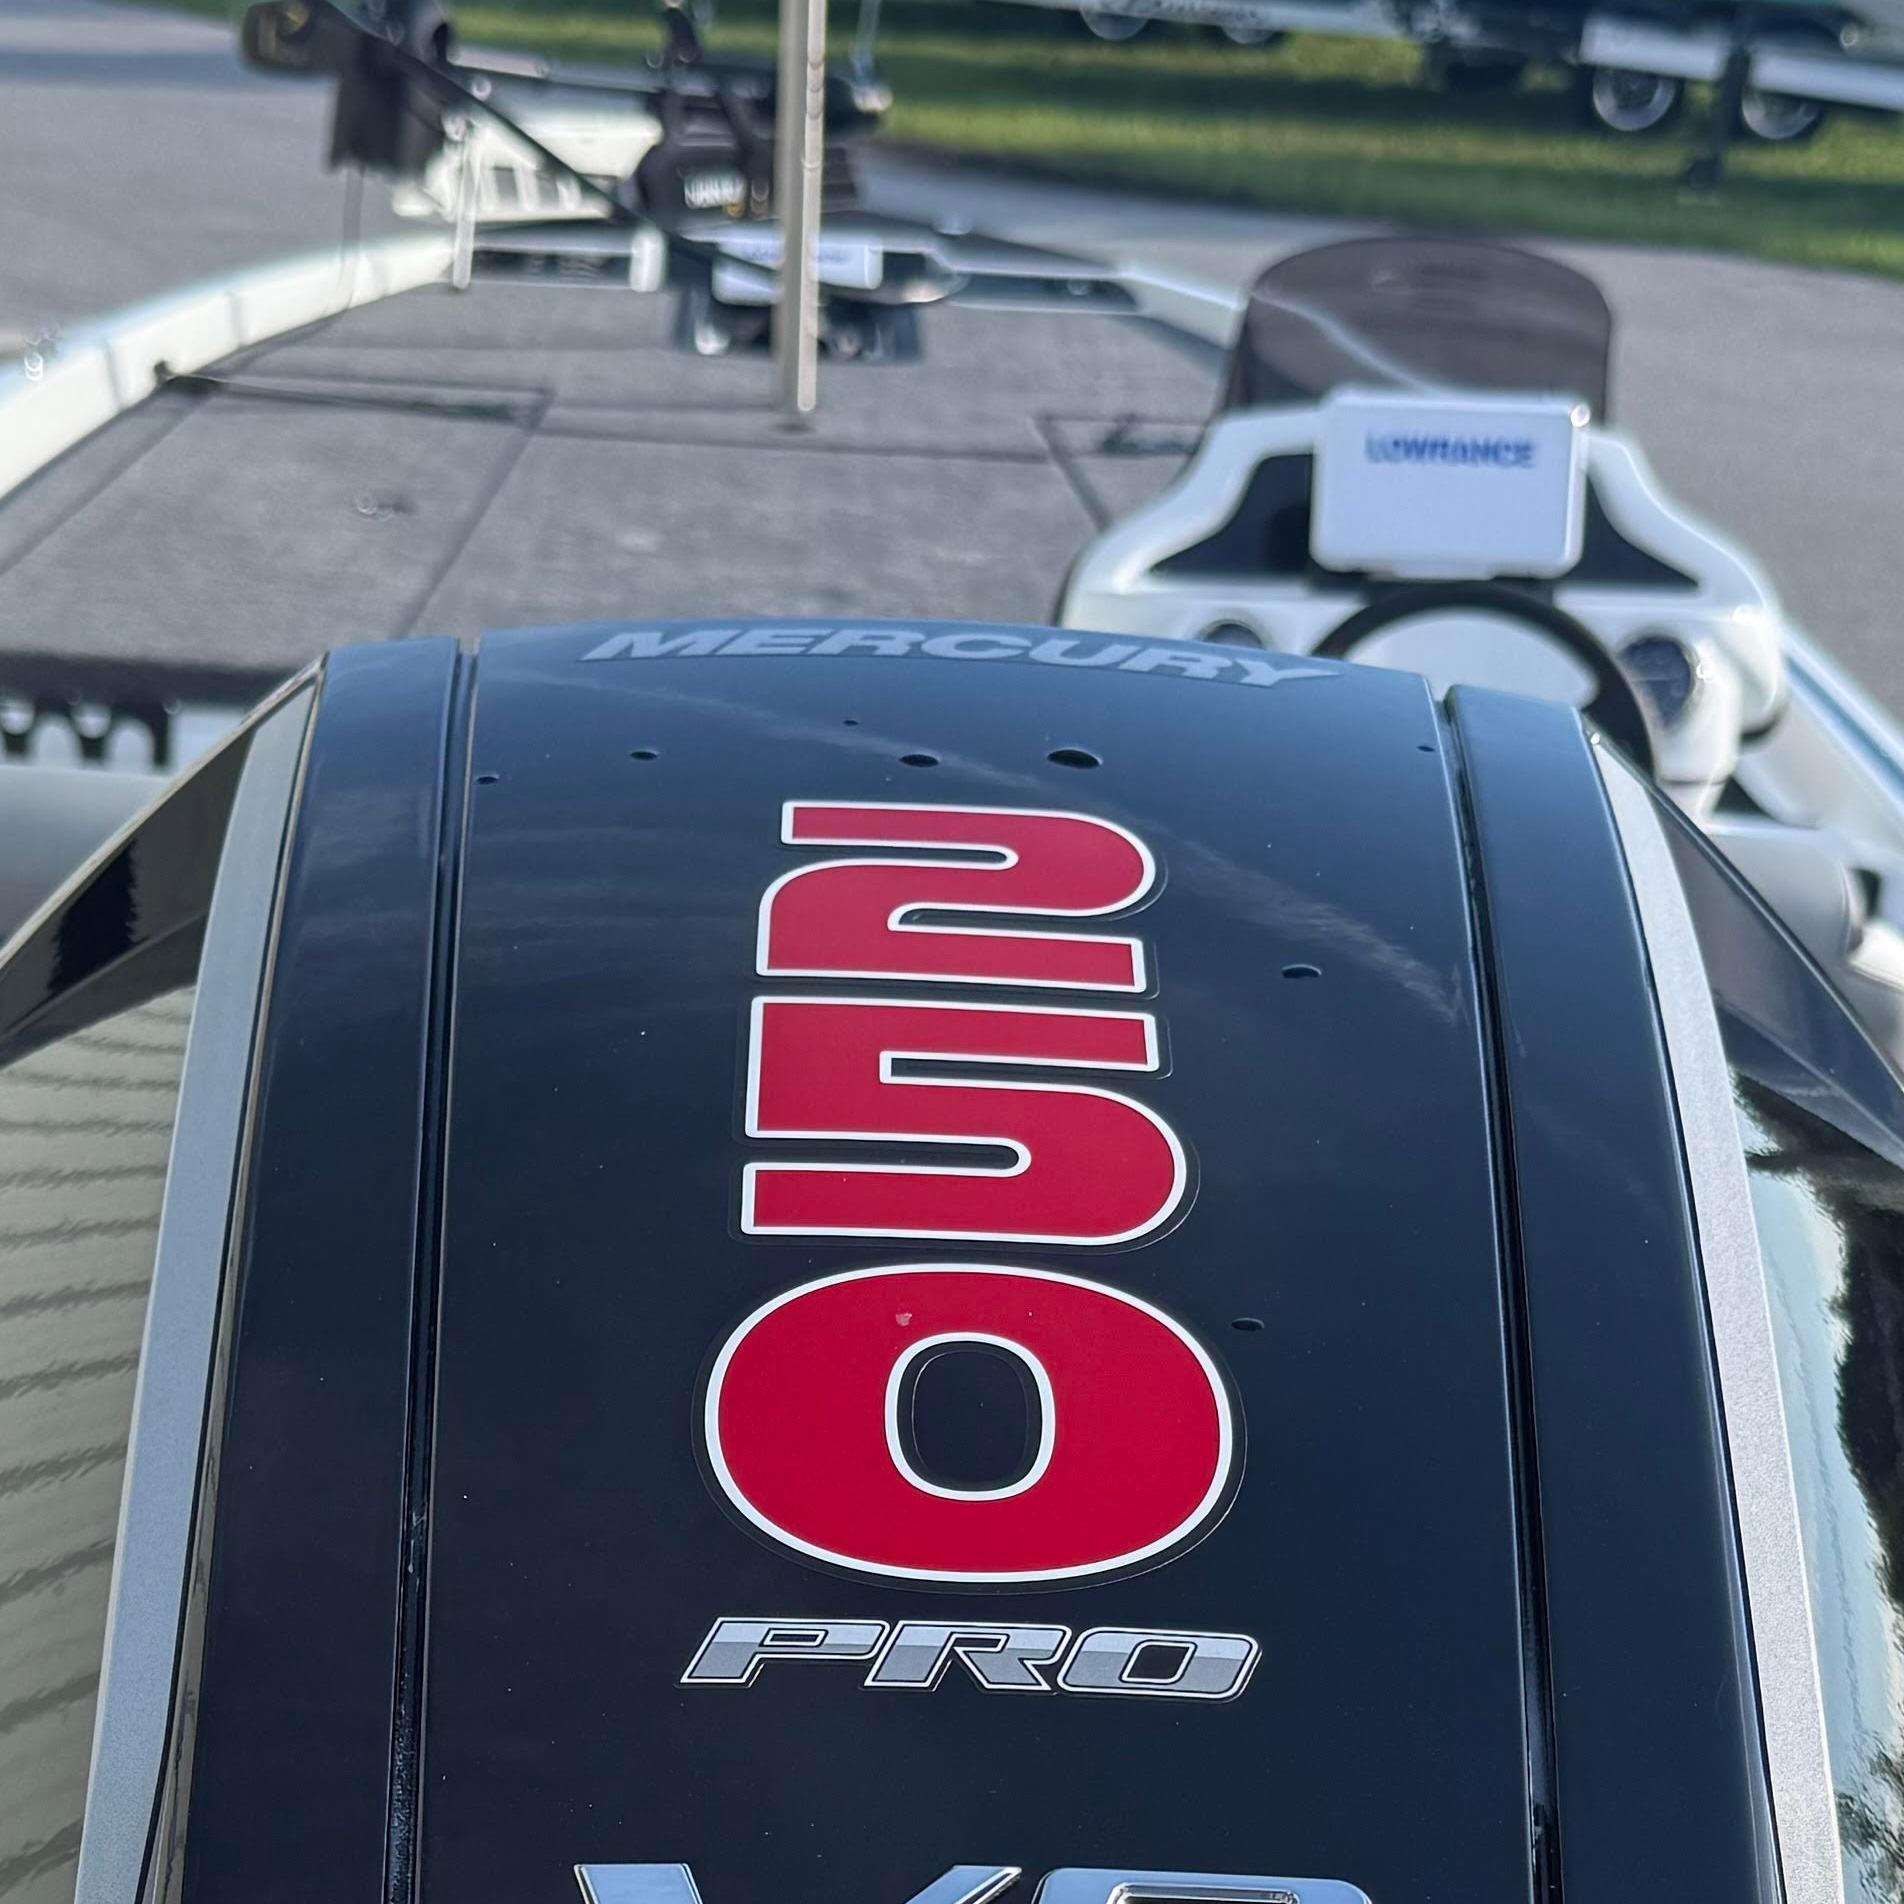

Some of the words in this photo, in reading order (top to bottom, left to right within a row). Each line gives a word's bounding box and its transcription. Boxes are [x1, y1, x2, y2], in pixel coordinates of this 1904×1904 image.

[1364, 434, 1534, 468] LOWRANCE
[580, 627, 1342, 687] MERCURY
[704, 800, 1234, 1583] 250
[679, 1616, 1260, 1701] PRO
